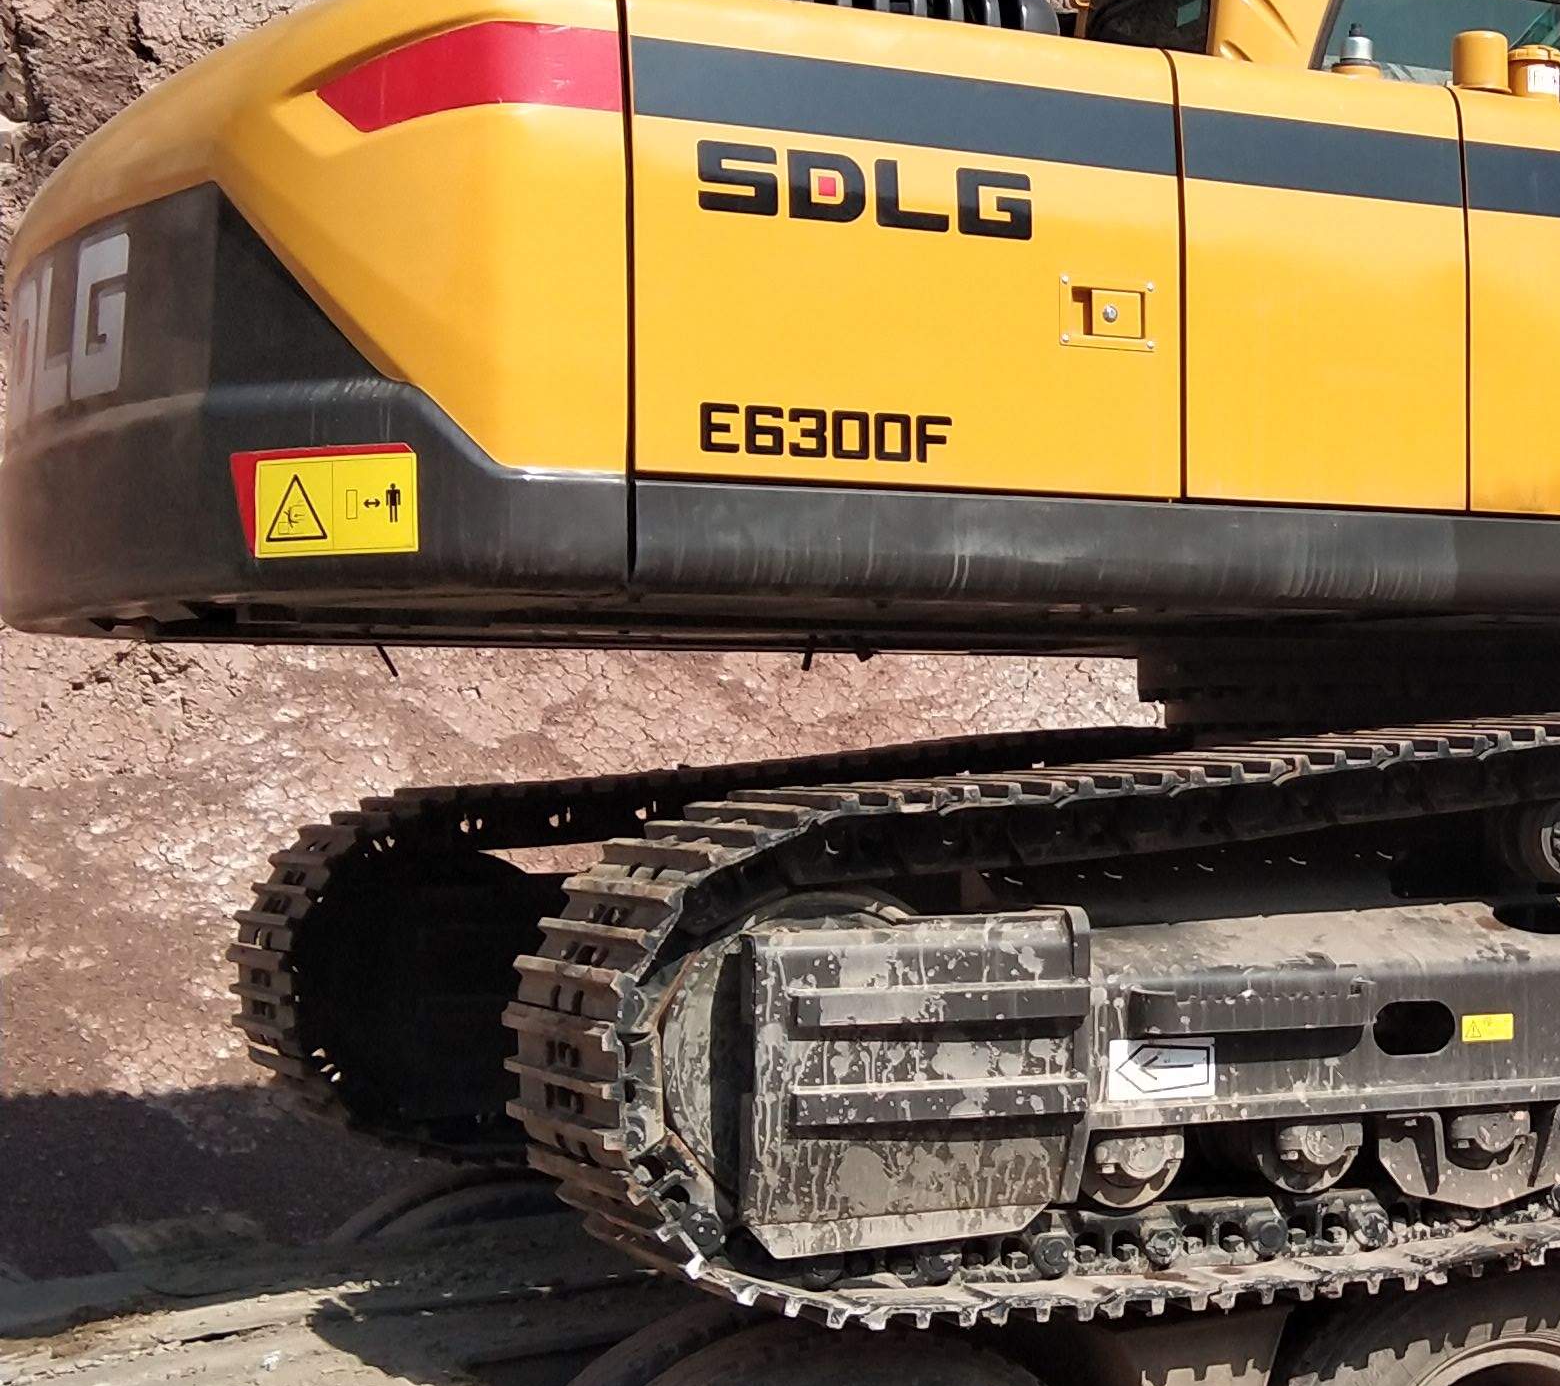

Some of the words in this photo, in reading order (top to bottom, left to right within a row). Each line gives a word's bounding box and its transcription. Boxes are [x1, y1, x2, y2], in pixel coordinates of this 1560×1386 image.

[697, 140, 1033, 241] SDLG
[9, 232, 131, 435] DLG
[700, 402, 953, 463] E6300F
